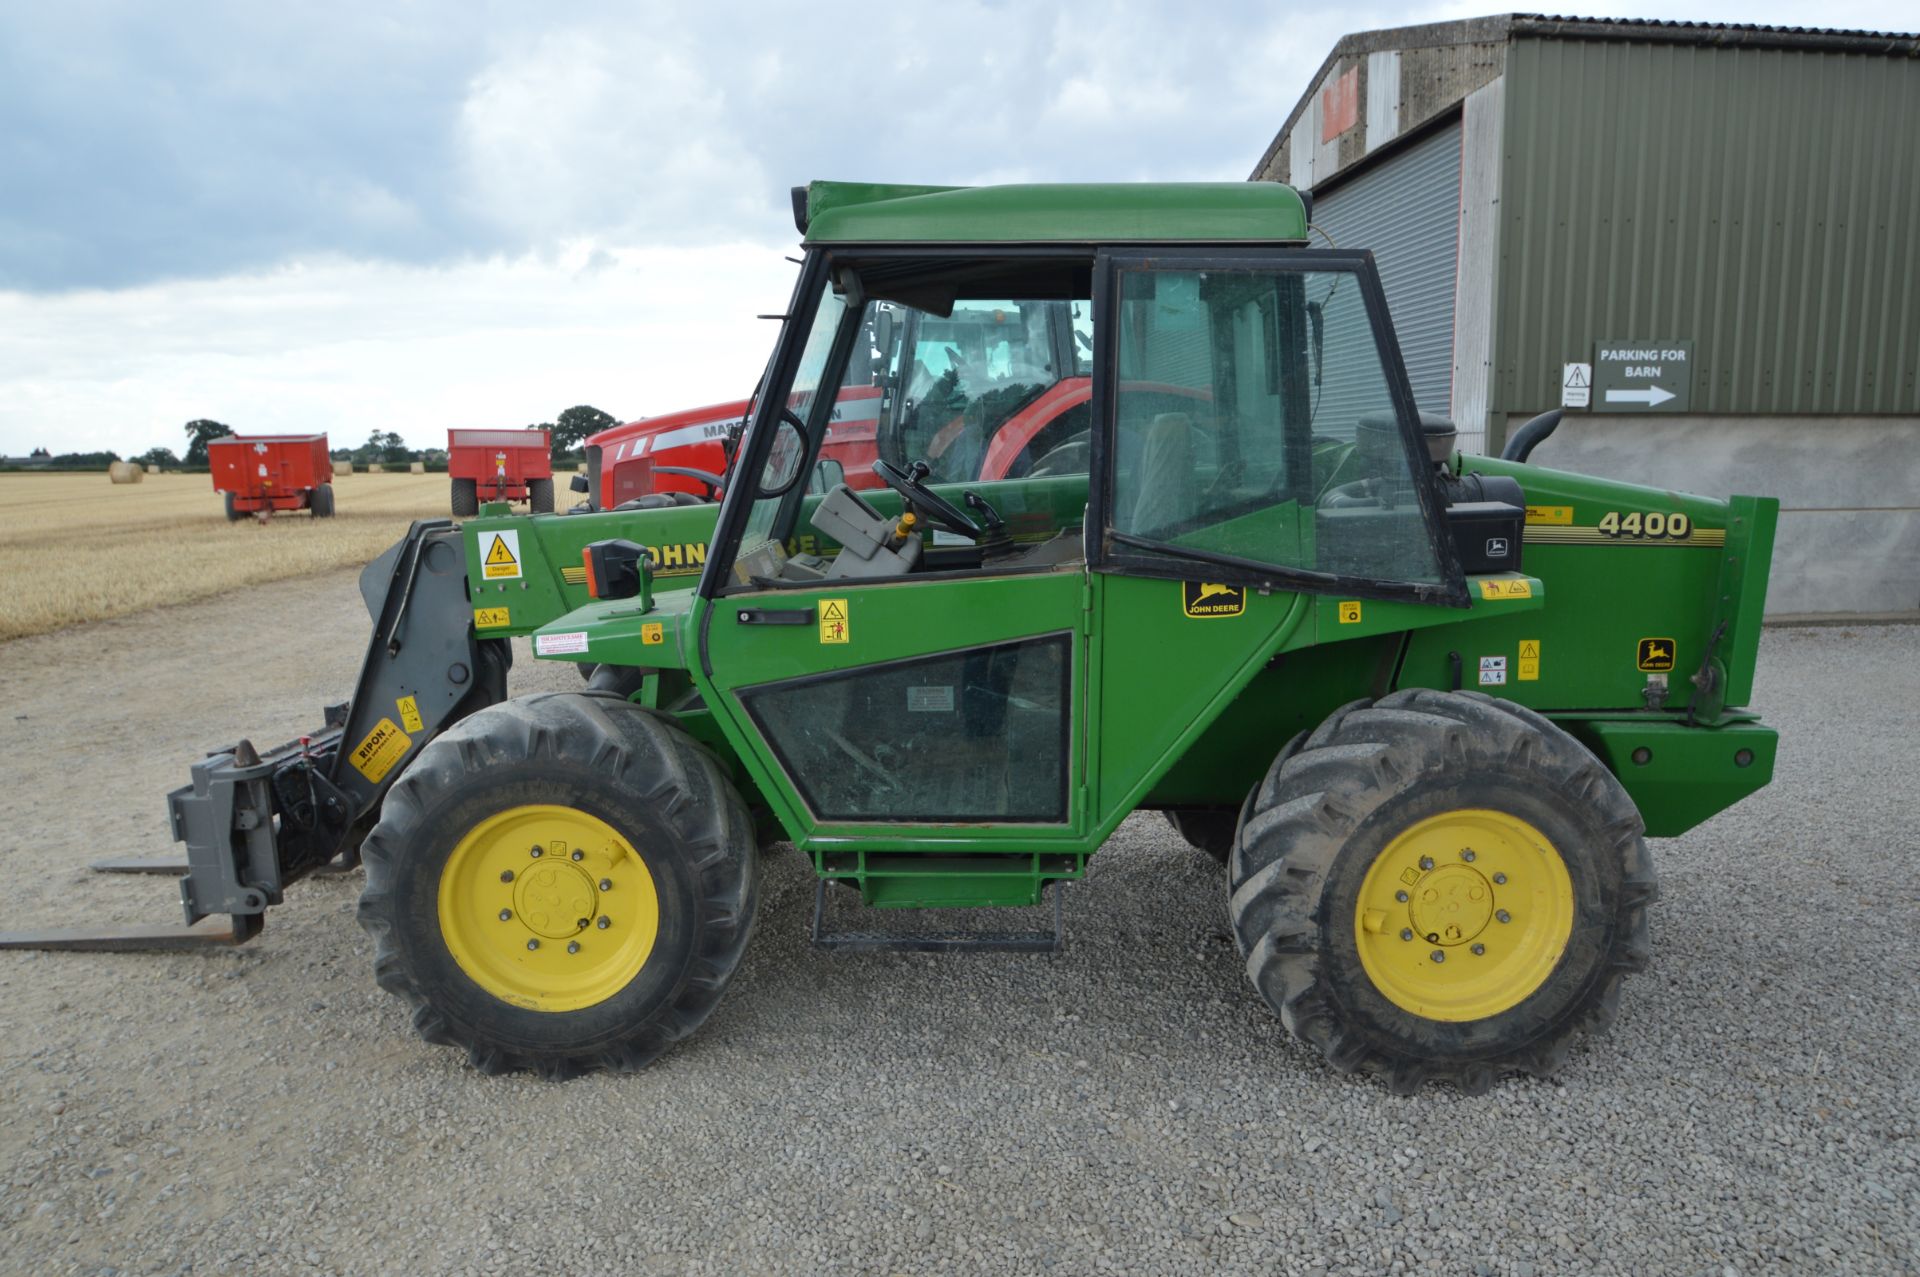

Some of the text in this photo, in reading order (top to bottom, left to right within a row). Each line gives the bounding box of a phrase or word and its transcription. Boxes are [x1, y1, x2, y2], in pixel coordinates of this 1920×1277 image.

[1600, 350, 1686, 360] PARKING FOR
[1625, 366, 1661, 377] BARN
[1598, 511, 1691, 538] 4400
[648, 543, 706, 567] OHN
[359, 729, 386, 759] RIPON
